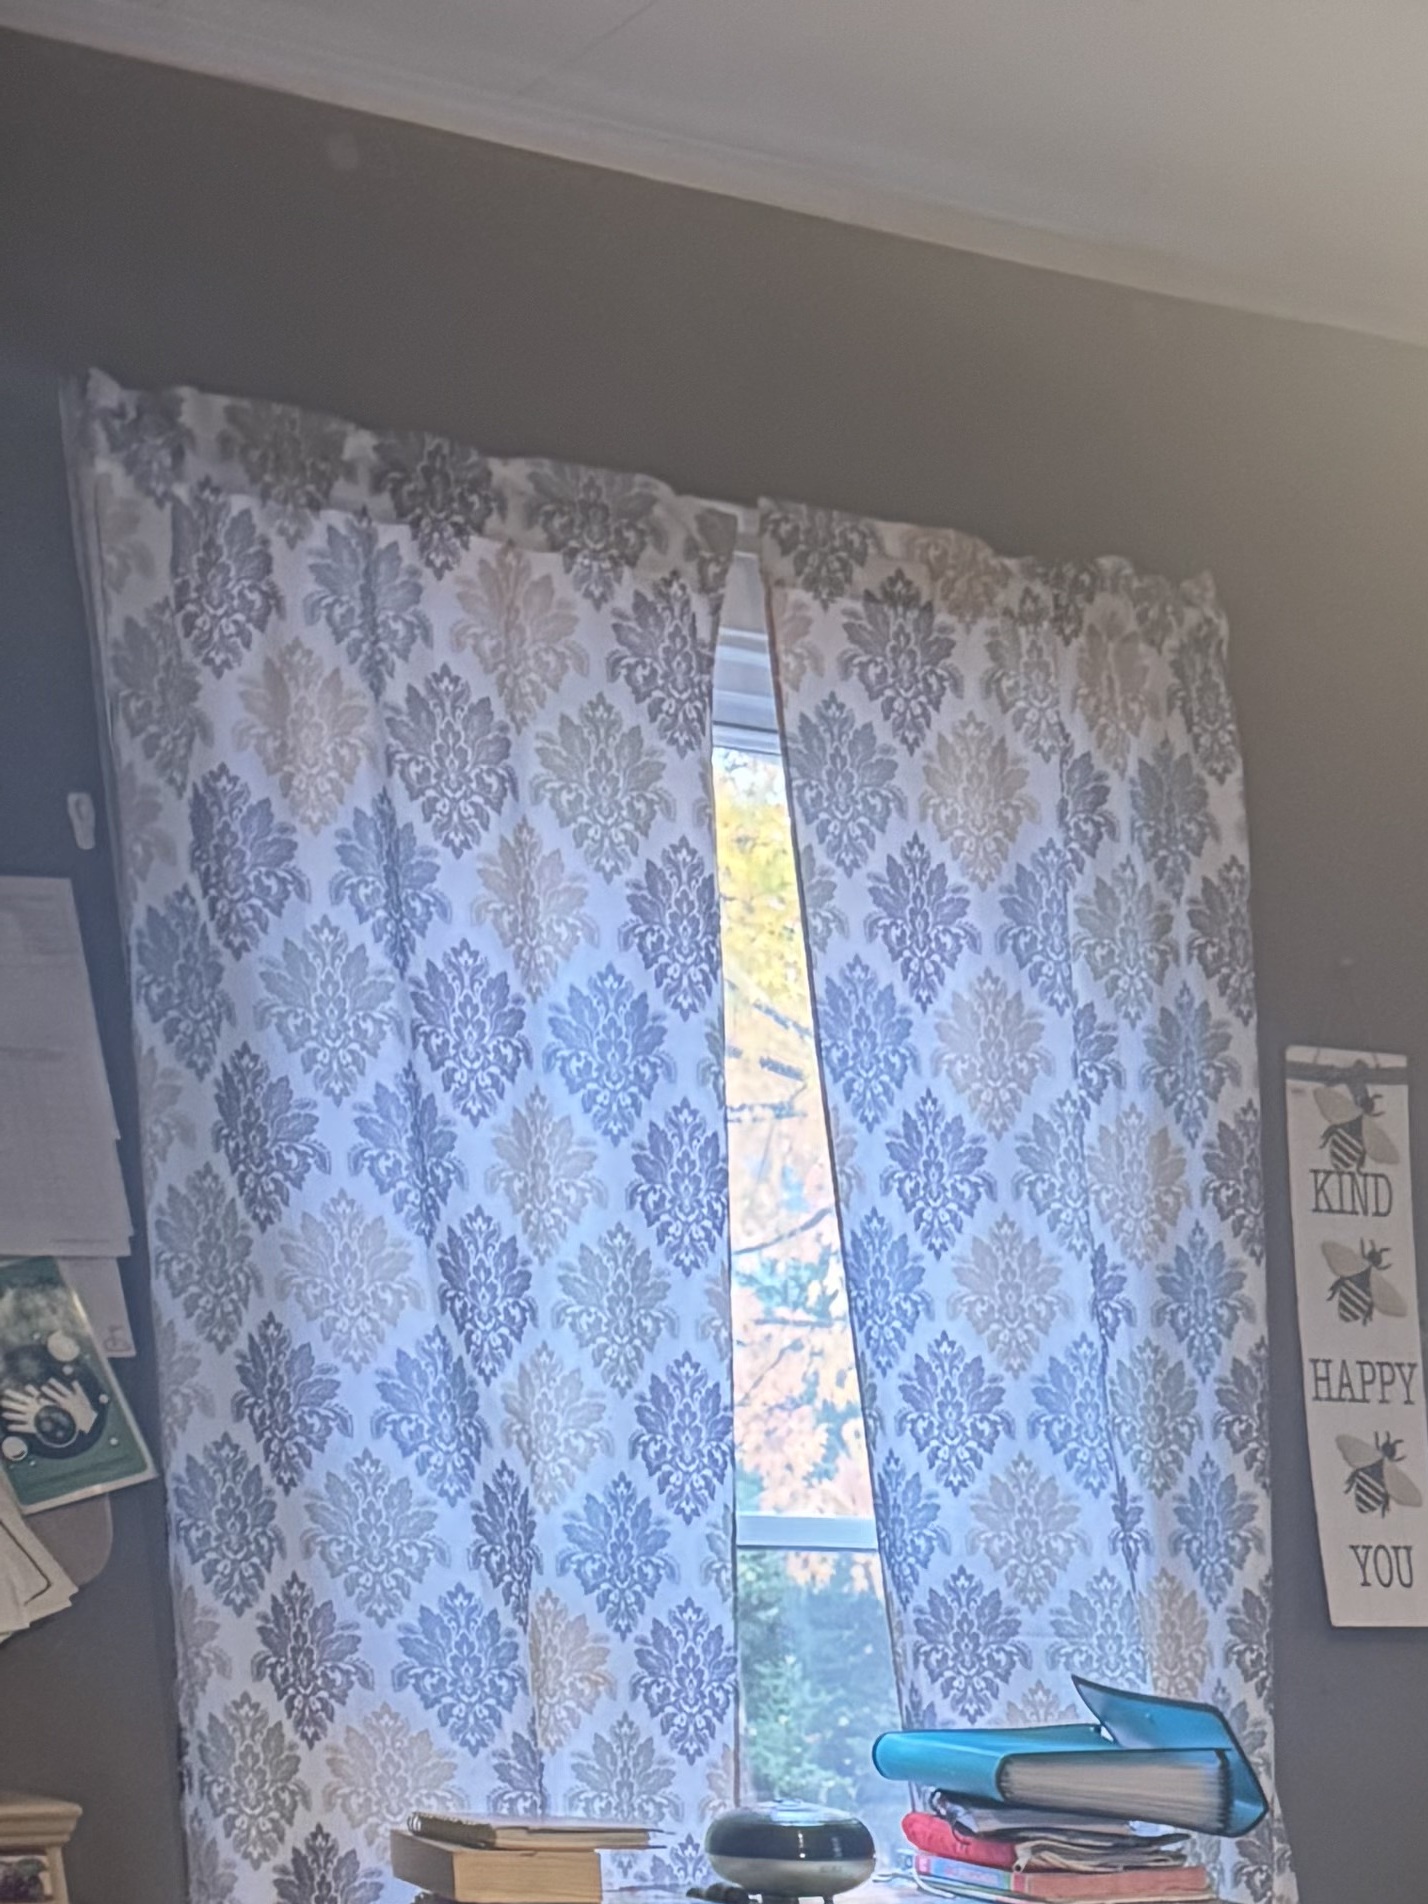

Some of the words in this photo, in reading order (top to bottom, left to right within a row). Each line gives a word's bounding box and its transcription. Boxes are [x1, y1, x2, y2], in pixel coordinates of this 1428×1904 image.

[1310, 1168, 1394, 1218] KIND
[1308, 1358, 1419, 1405] HAPPY
[1350, 1544, 1415, 1589] YOU
